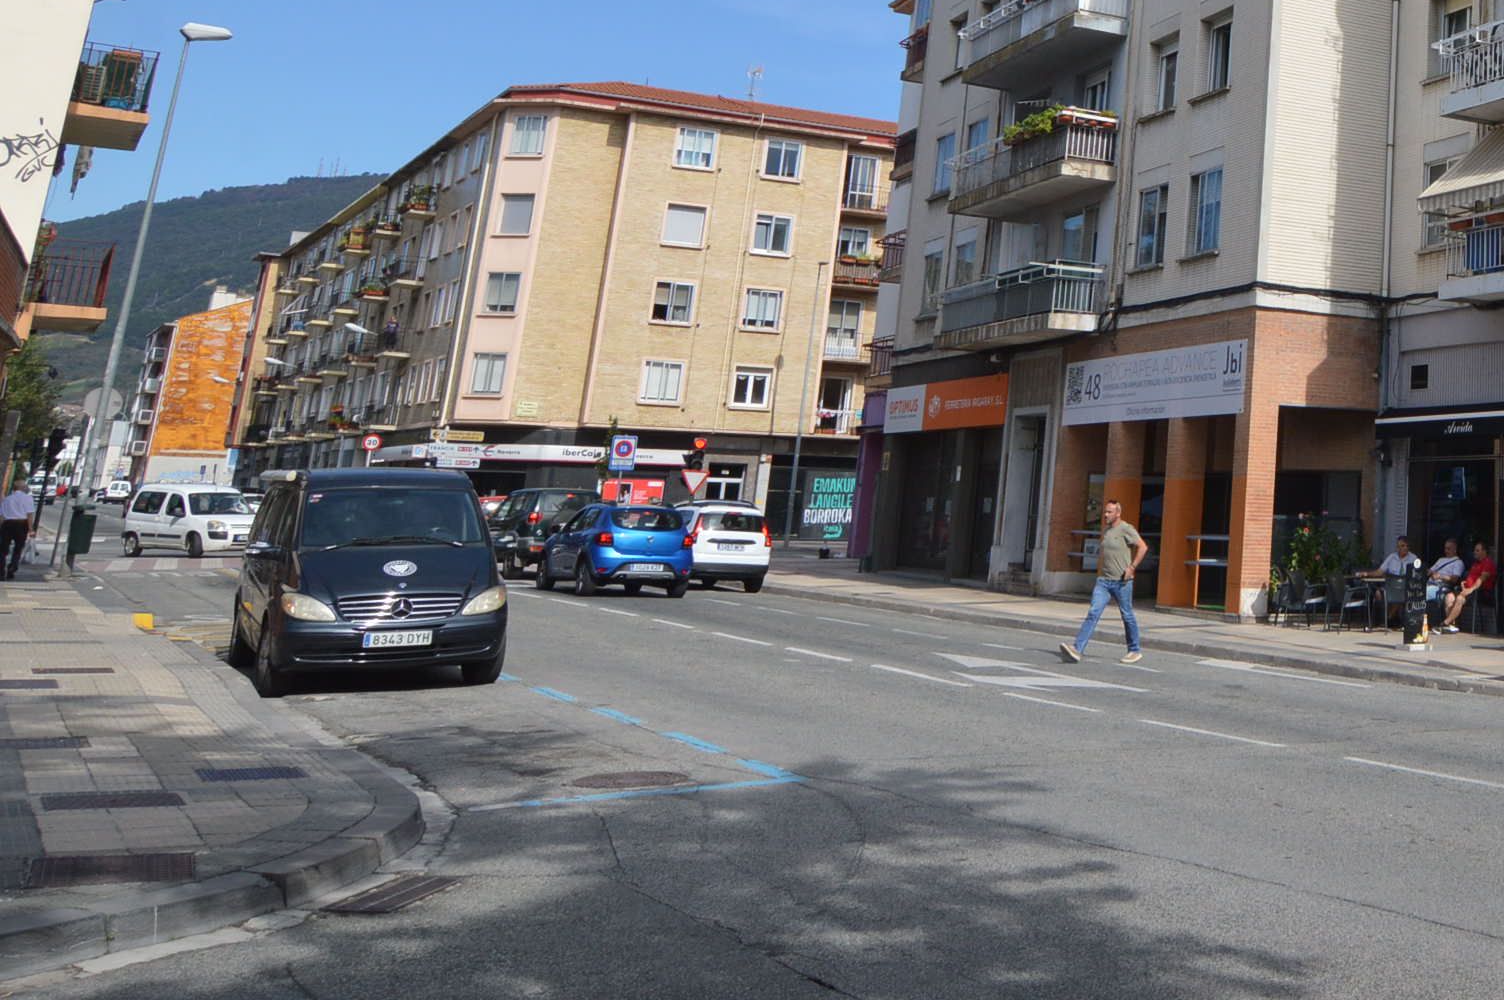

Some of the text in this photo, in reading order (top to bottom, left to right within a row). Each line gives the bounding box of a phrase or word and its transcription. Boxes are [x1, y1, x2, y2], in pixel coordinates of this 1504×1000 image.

[1162, 350, 1217, 375] ADVANCE
[1084, 374, 1102, 400] 48
[1443, 421, 1473, 434] Arvida
[803, 508, 853, 524] BORROKA
[372, 632, 431, 646] 8343 DYH
